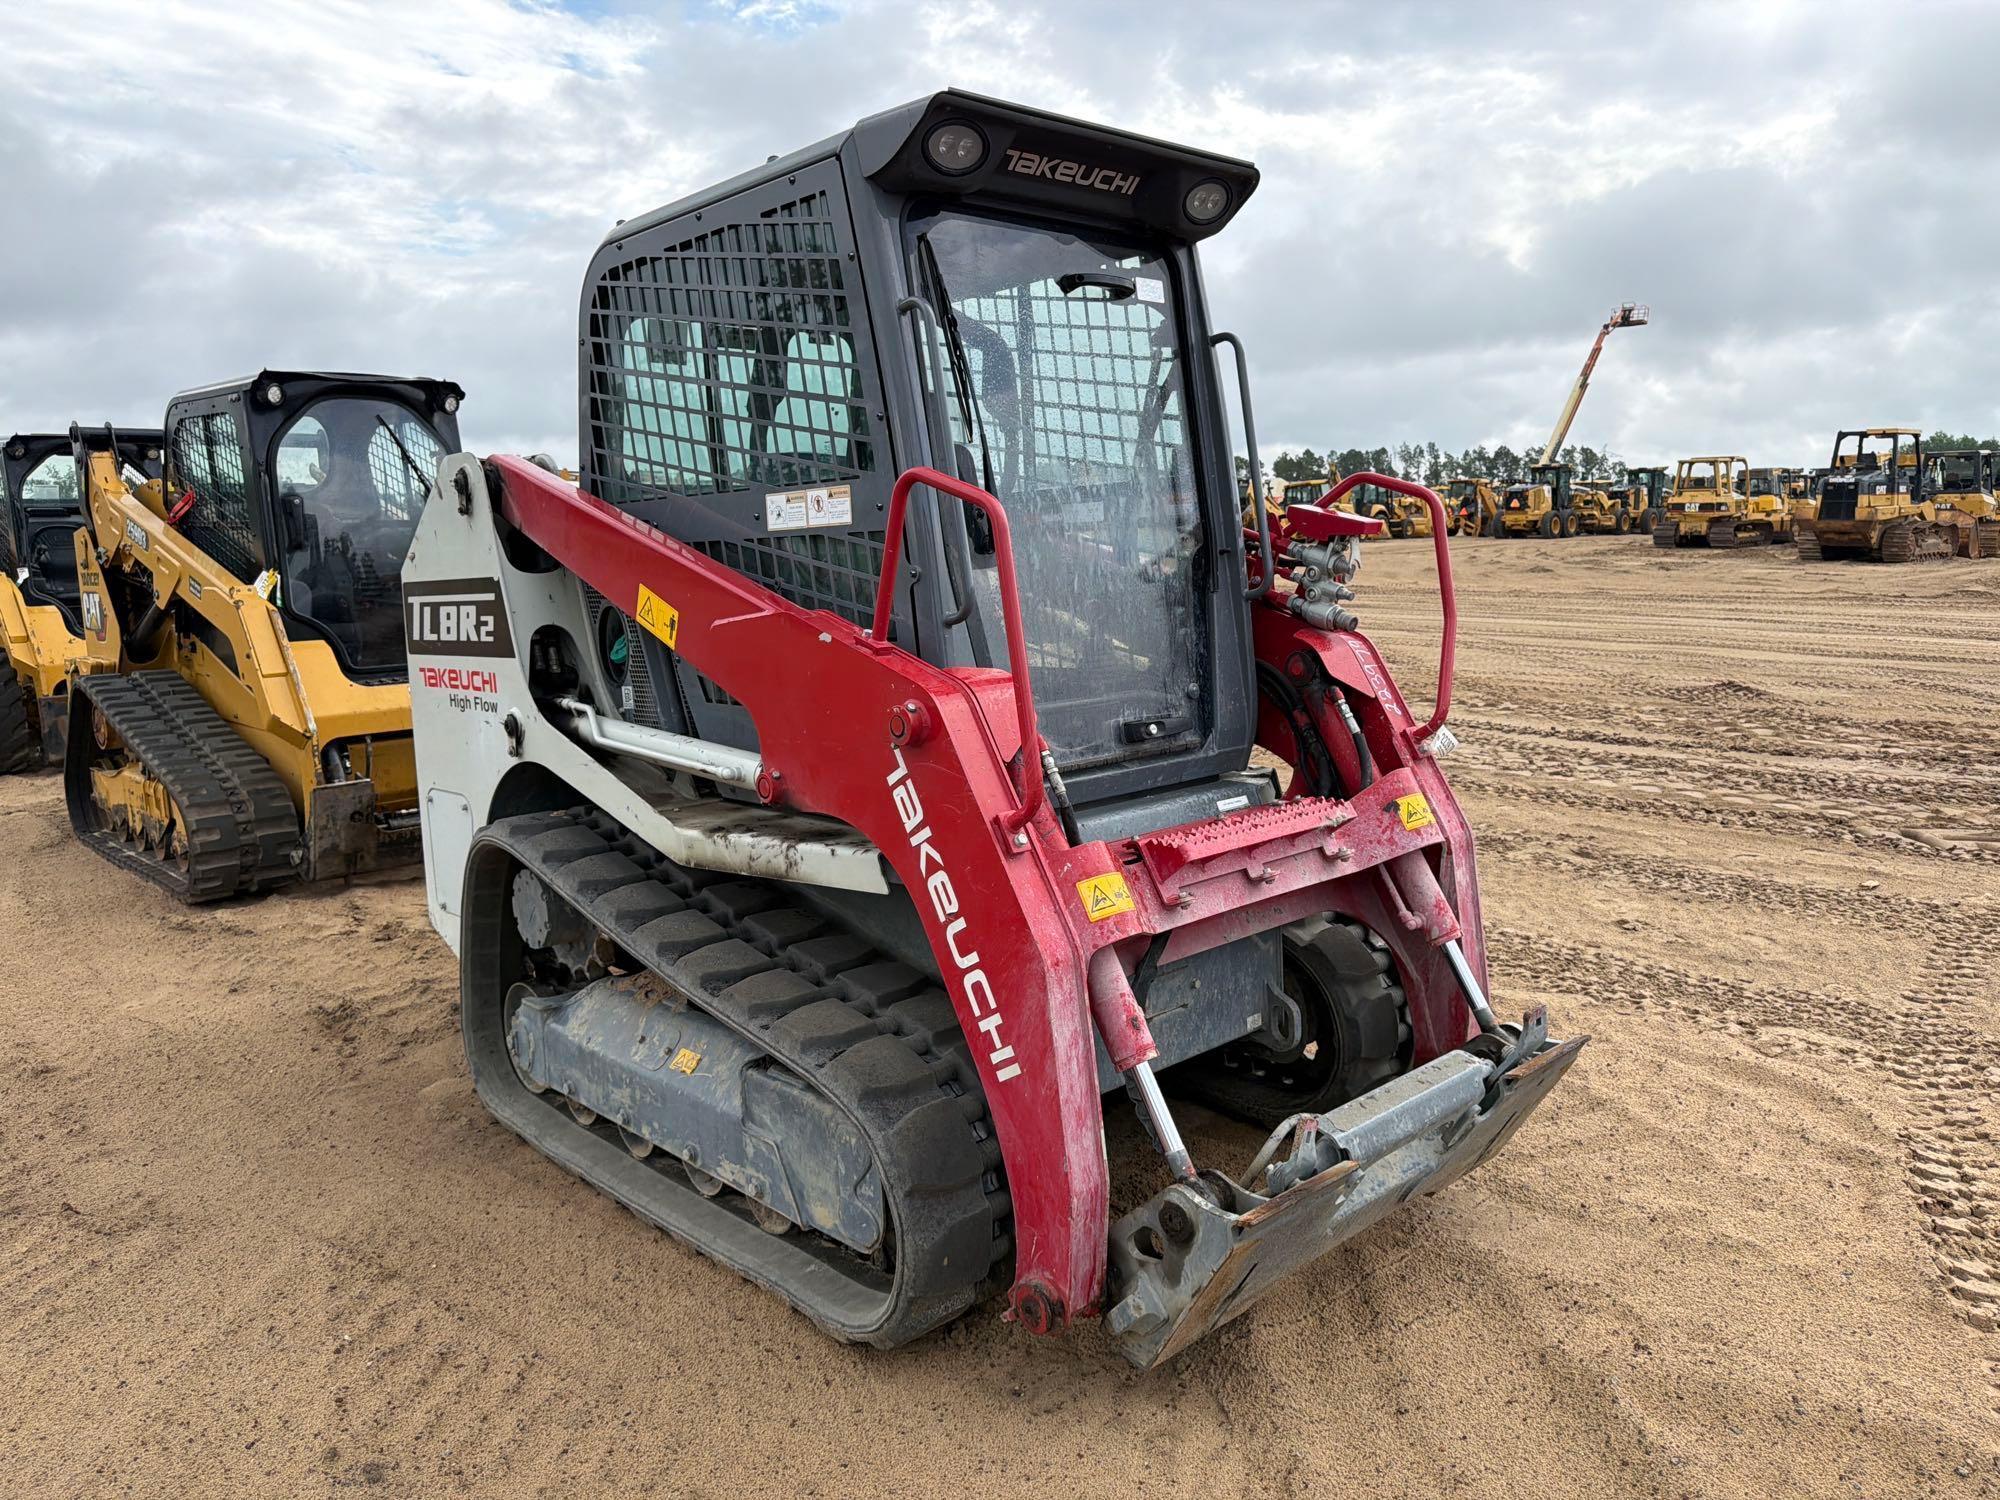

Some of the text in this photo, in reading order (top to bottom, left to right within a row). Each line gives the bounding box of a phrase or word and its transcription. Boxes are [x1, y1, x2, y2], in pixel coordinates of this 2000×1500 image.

[1006, 149, 1141, 195] TAKEUCHI
[1876, 485, 1887, 495] CAT
[1685, 503, 1700, 513] CAT
[82, 592, 102, 631] CAT
[419, 667, 498, 694] TAKEUCHI
[449, 694, 498, 713] High Flow
[886, 748, 1022, 1083] TAKEUCHI
